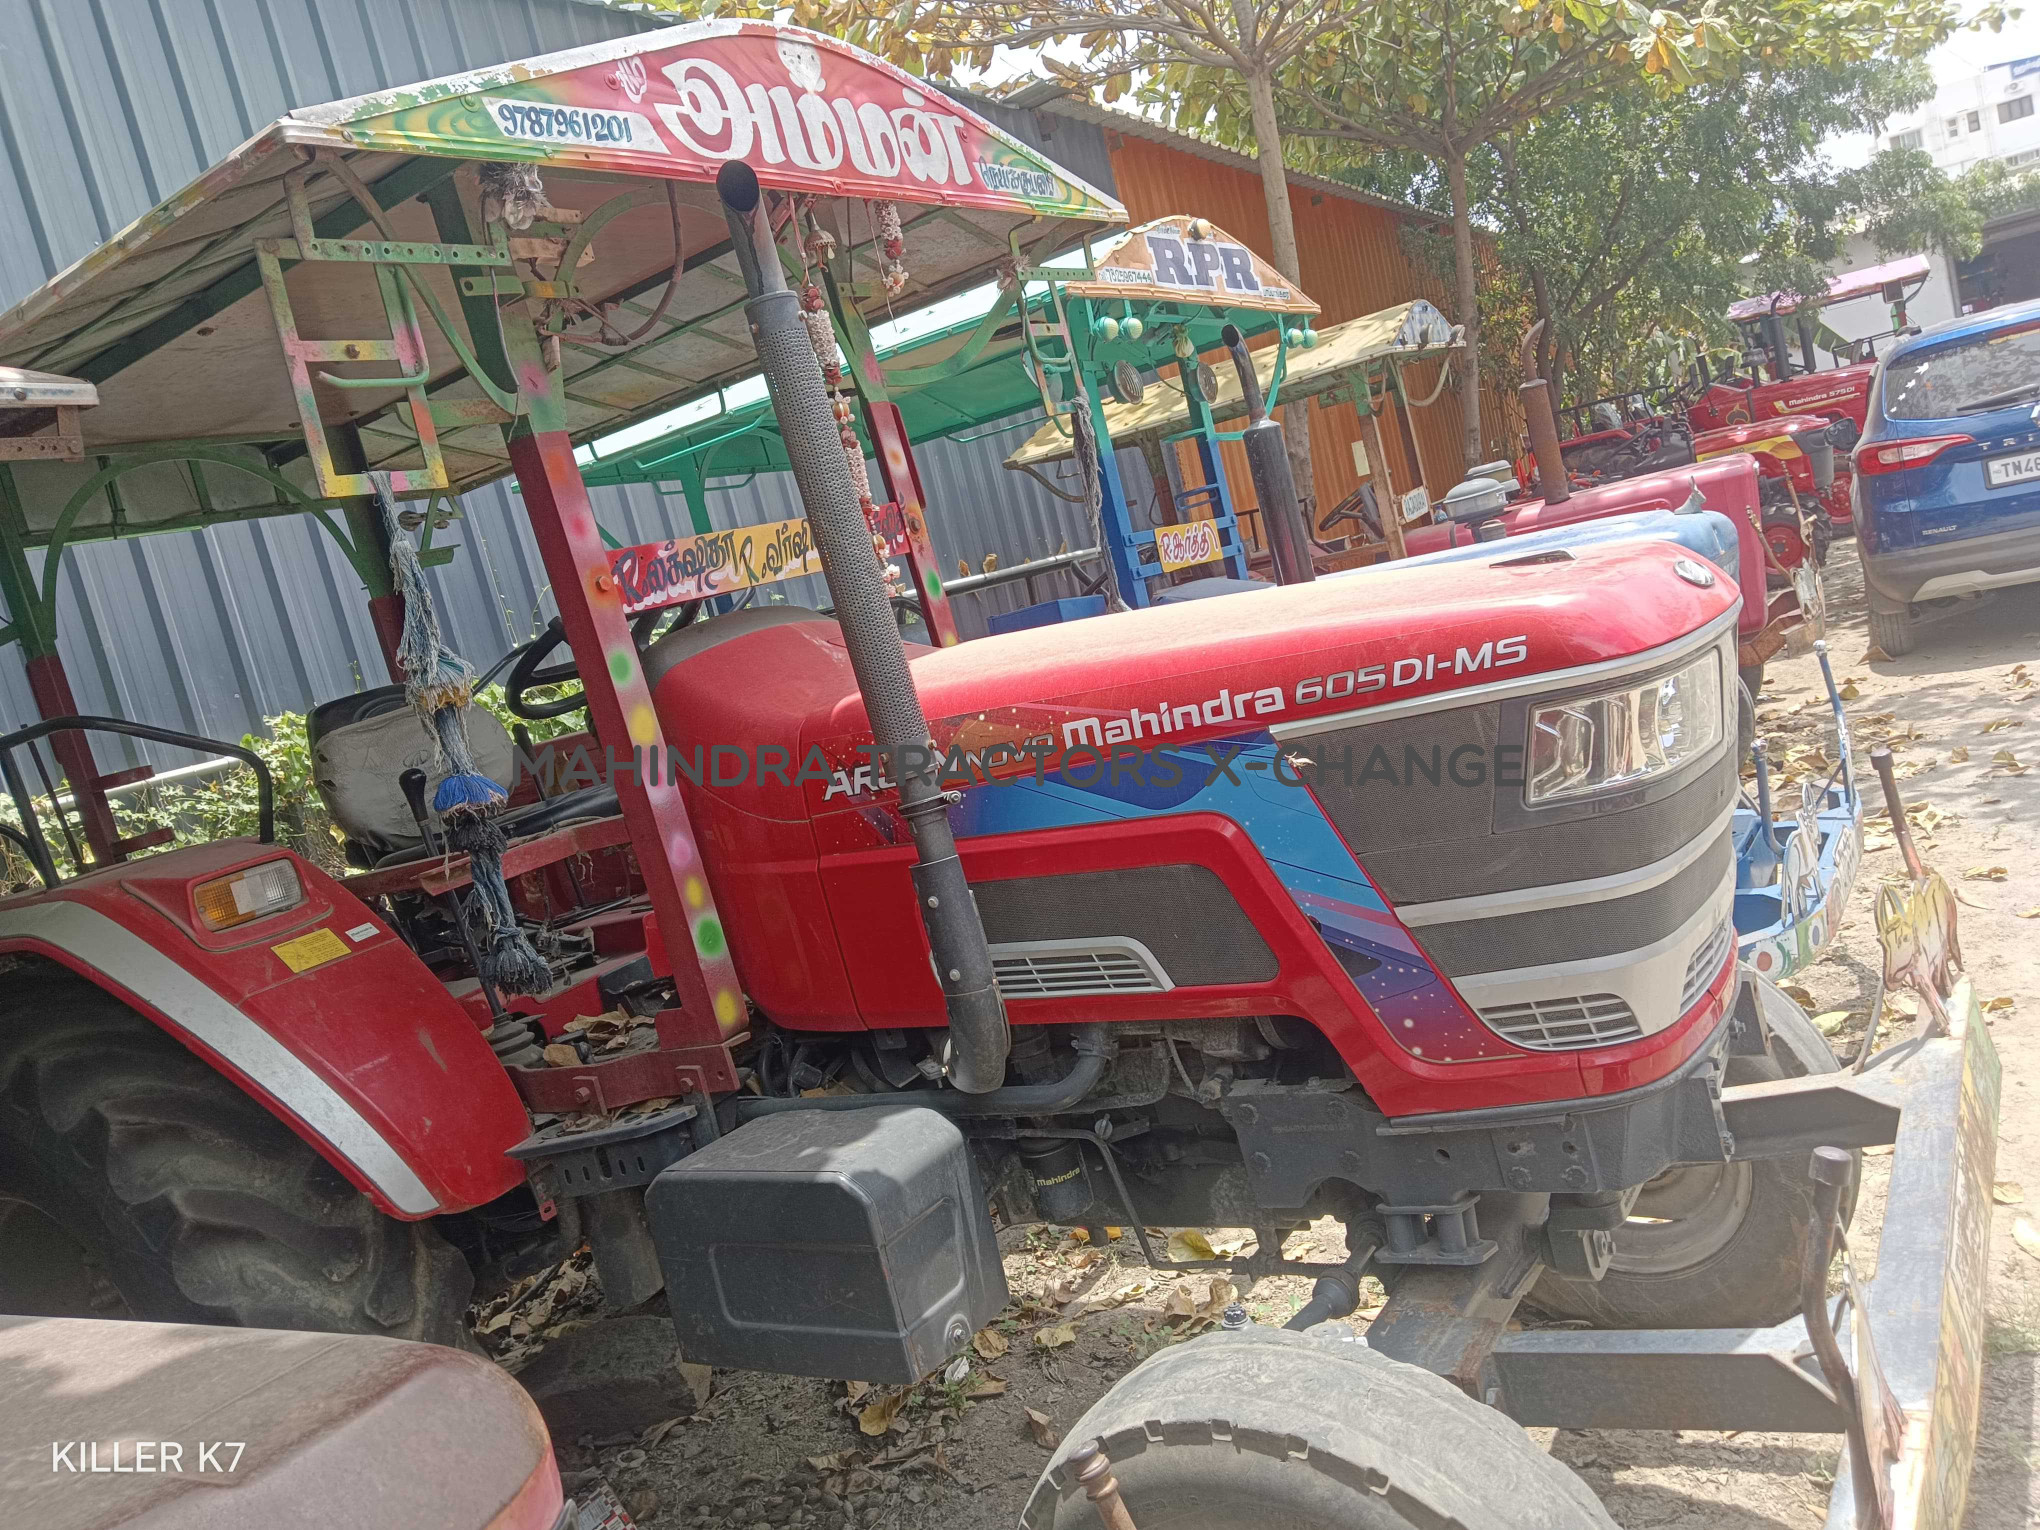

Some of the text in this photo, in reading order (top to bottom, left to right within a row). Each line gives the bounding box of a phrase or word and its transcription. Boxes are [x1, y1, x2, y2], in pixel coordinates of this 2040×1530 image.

[498, 94, 633, 143] 9787961201
[652, 40, 973, 186] அம்மன்
[1146, 235, 1260, 292] RPR
[1788, 393, 1827, 406] Mahindra
[1061, 635, 1528, 752] Mahindra 605 DI-MS
[1036, 1167, 1081, 1187] Mahindra
